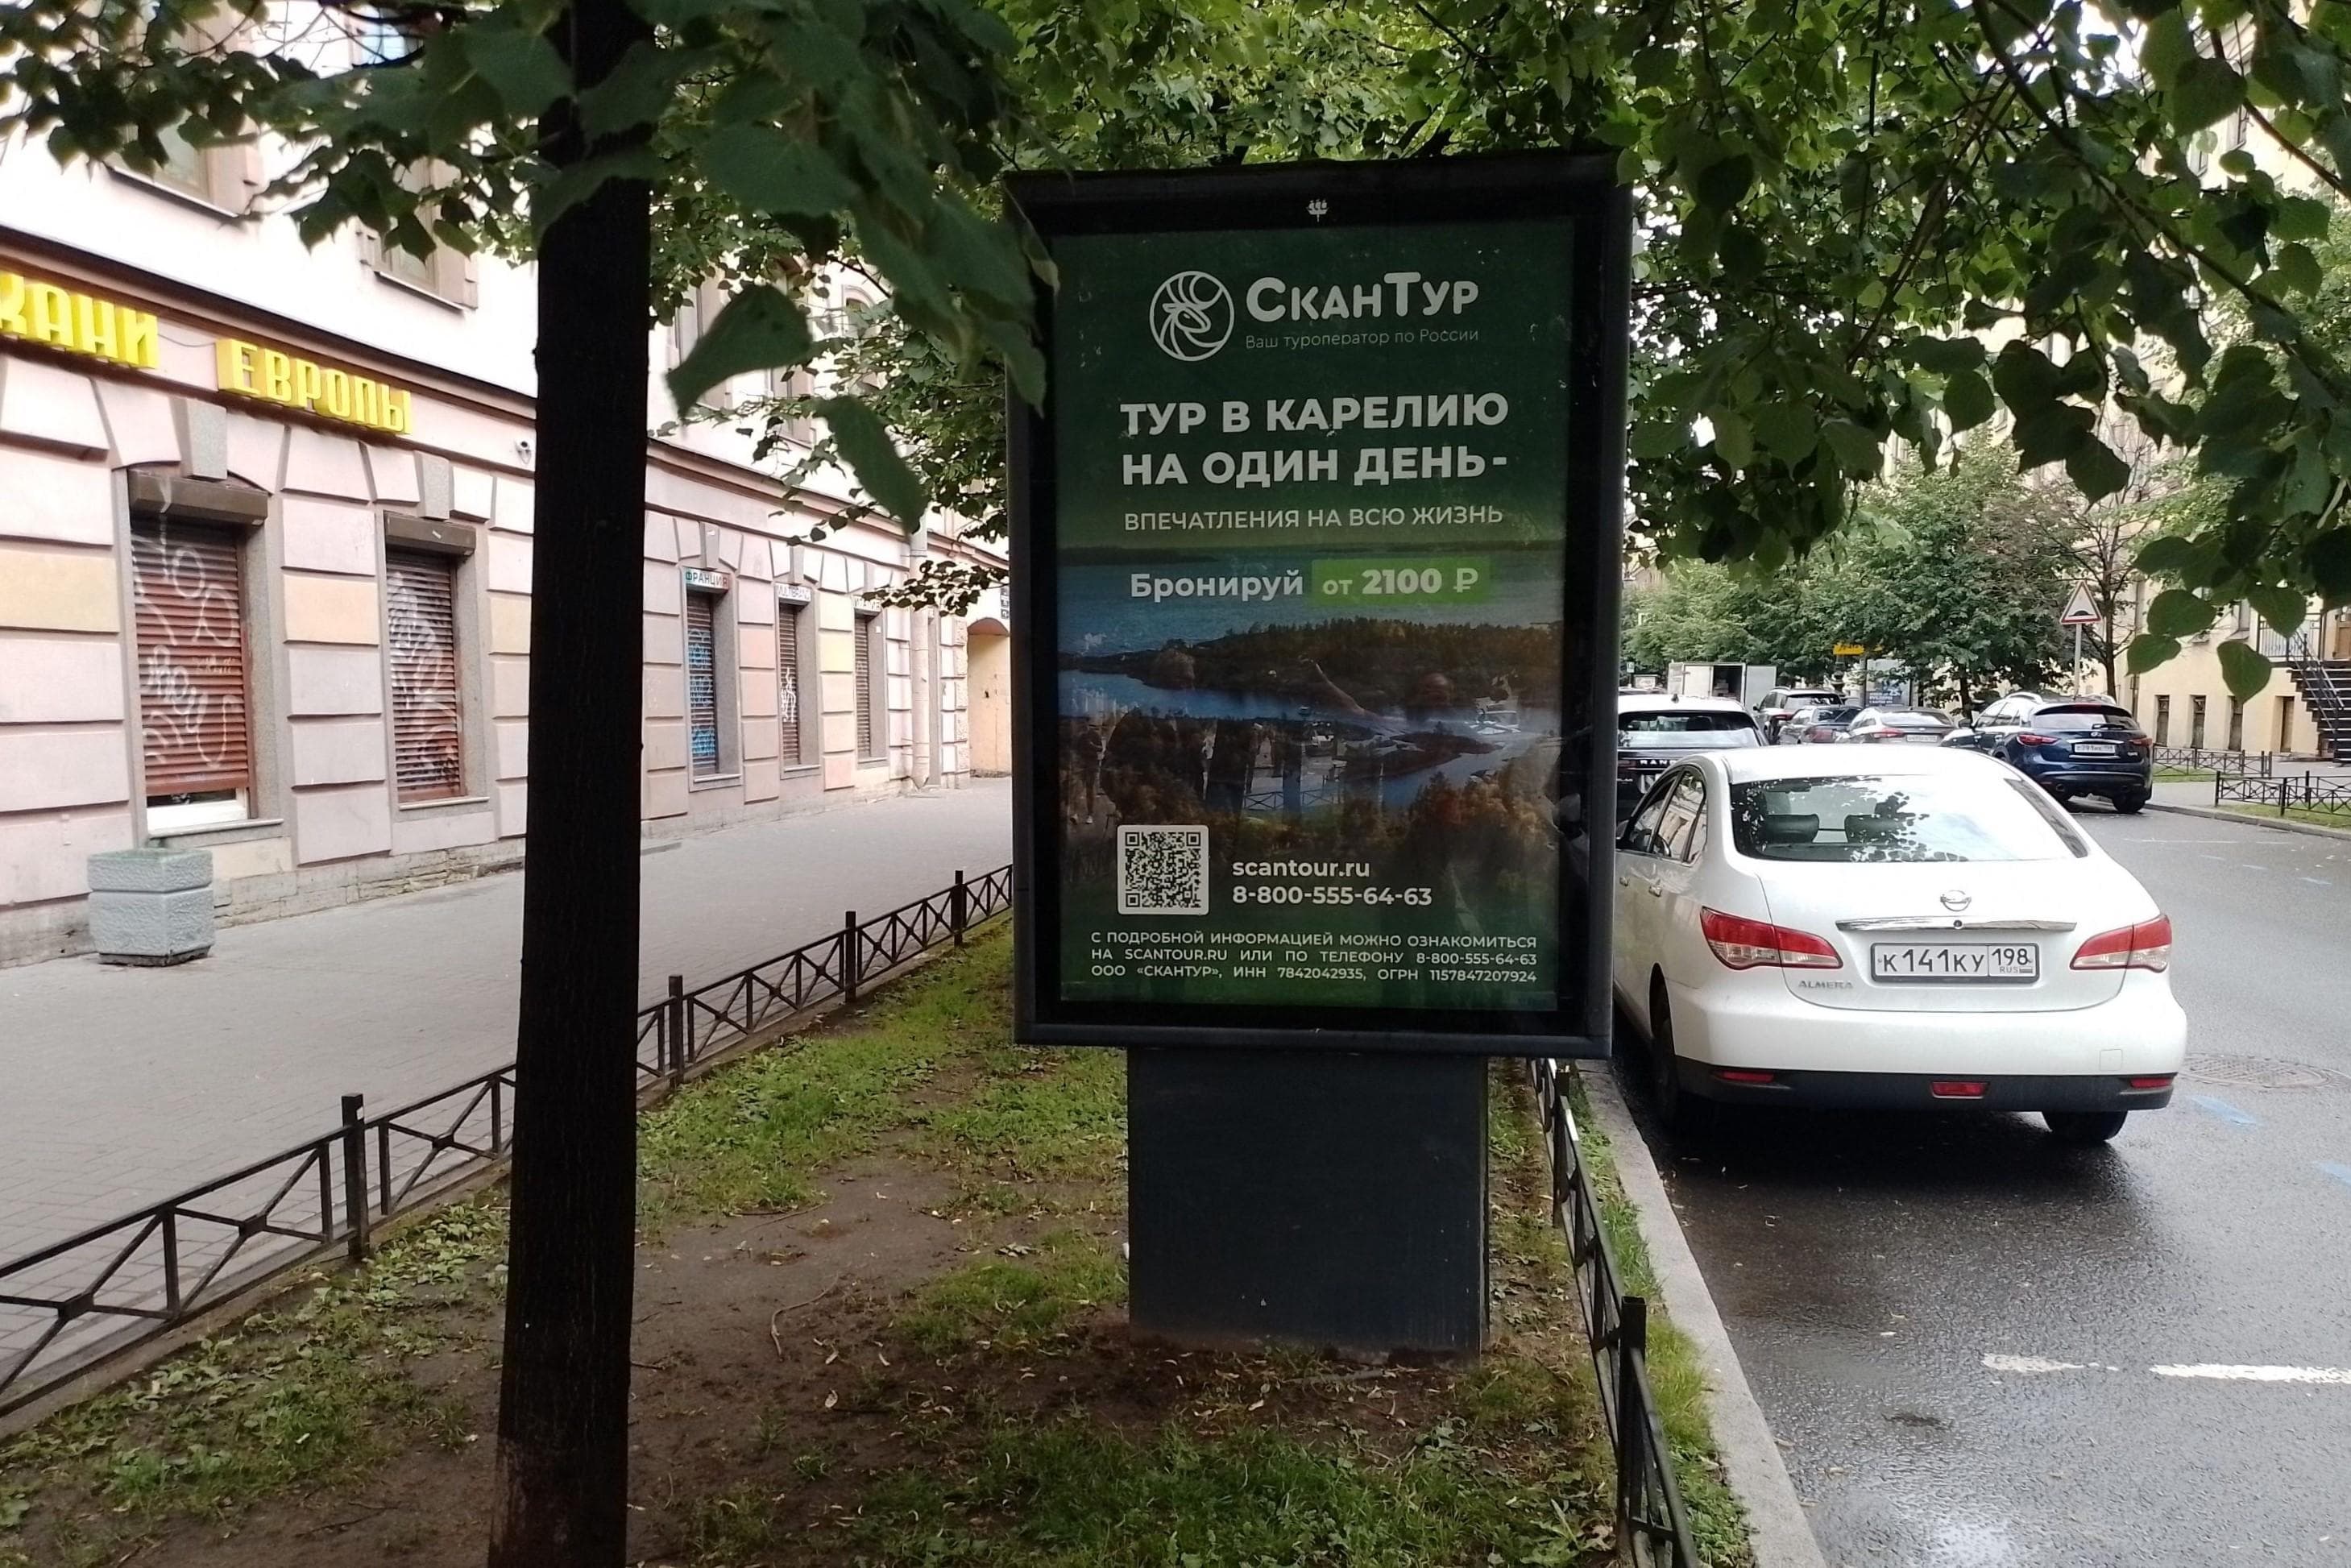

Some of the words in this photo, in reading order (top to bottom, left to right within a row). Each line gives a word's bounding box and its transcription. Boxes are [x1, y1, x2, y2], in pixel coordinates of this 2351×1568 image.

[1246, 335, 1278, 349] Ваш
[1283, 332, 1390, 351] туроператор
[1395, 332, 1415, 342] по
[1420, 328, 1478, 342] России
[216, 338, 412, 435] ЕВРОПЫ
[1120, 402, 1207, 436] ТУР
[1222, 400, 1250, 433] В
[1267, 392, 1508, 431] КАРЕЛИЮ
[1122, 453, 1188, 486] НА
[1202, 449, 1338, 488] ОДИН
[1125, 509, 1300, 531] ВПЕЧАТЛЕНИЯ
[1308, 509, 1337, 527] НА
[1350, 508, 1405, 526] ВСЮ
[1412, 505, 1503, 525] ЖИЗНЬ
[685, 571, 728, 587] ФРАНЦИЯ
[1131, 569, 1303, 603] Бронируй
[1322, 579, 1353, 595] от
[1362, 567, 1442, 595] 2100
[1233, 860, 1370, 877] scantour.ru
[1233, 886, 1433, 906] 8-800-555-64-63
[1091, 931, 1101, 943] С
[1107, 930, 1204, 945] ПОДРОБНОЙ
[1210, 931, 1333, 947] ИНФОРМАЦИЕЙ
[1340, 934, 1402, 947] МОЖНО
[1407, 935, 1536, 948] ОЗНАКОМИТЬСЯ
[1092, 948, 1113, 960] НА
[1125, 948, 1228, 960] SCANTOUR.RU
[1240, 949, 1272, 961] ИЛИ
[1285, 950, 1308, 962] ПО
[1319, 951, 1404, 964] ТЕЛЕФОНУ
[1416, 952, 1537, 965] 8-800-555-64-63
[1991, 948, 2030, 966] 198
[1091, 964, 1126, 977] ООО
[1137, 964, 1222, 979] «СКАНТУР»,
[1234, 966, 1267, 977] ИНН
[1277, 967, 1366, 981] 7842042935,
[1377, 969, 1419, 981] ОГРН
[1429, 969, 1537, 982] 1157847207924
[1798, 980, 1853, 989] ALMERA
